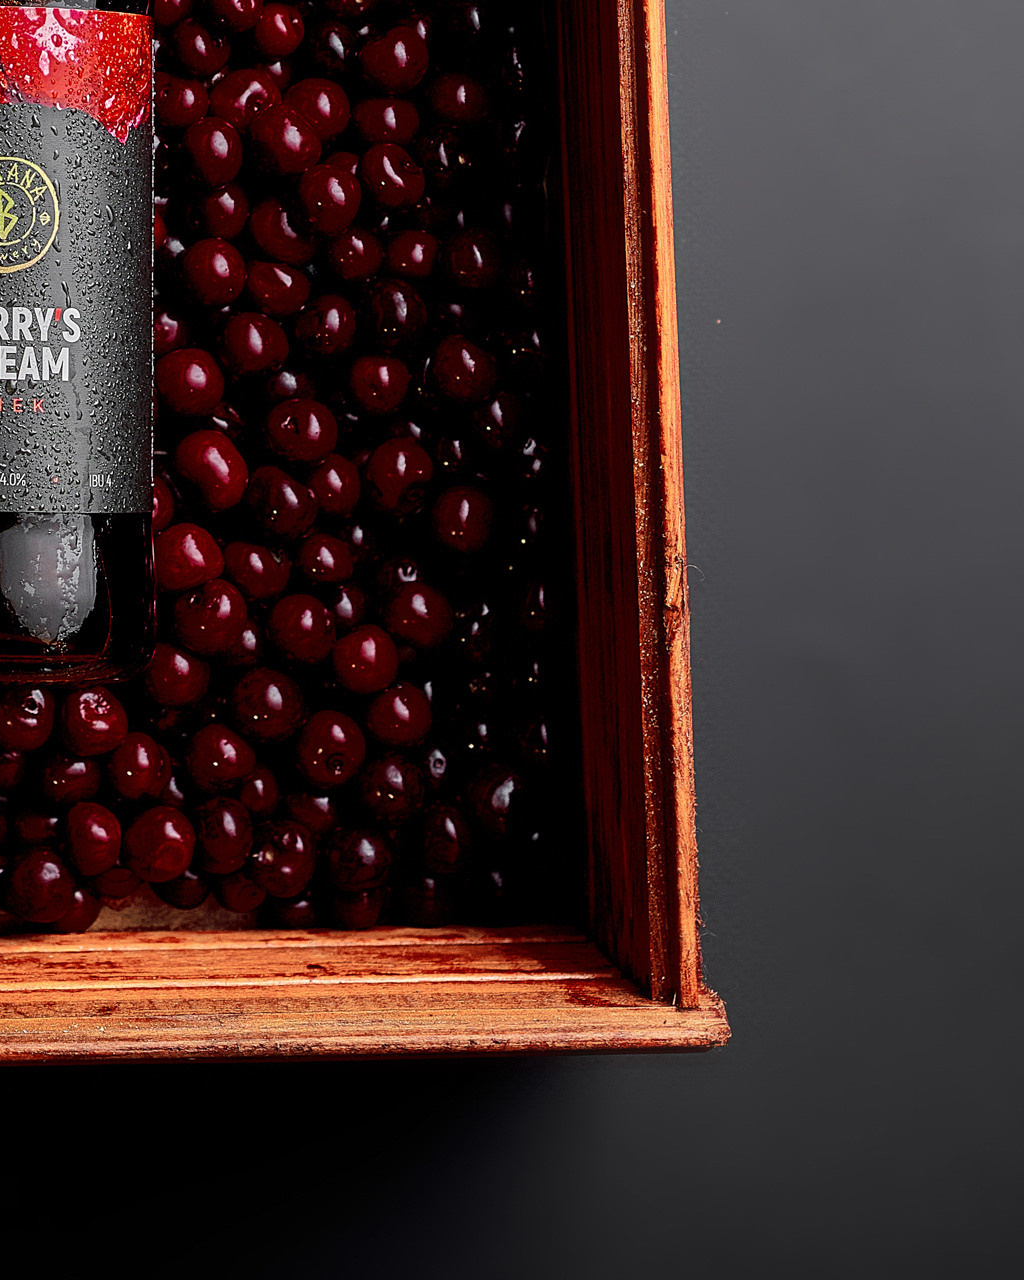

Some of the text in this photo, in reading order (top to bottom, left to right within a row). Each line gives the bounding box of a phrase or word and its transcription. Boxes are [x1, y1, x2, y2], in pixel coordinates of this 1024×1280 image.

[0, 472, 26, 487] 4.0%
[89, 474, 104, 487] IBU
[105, 474, 113, 487] 4
